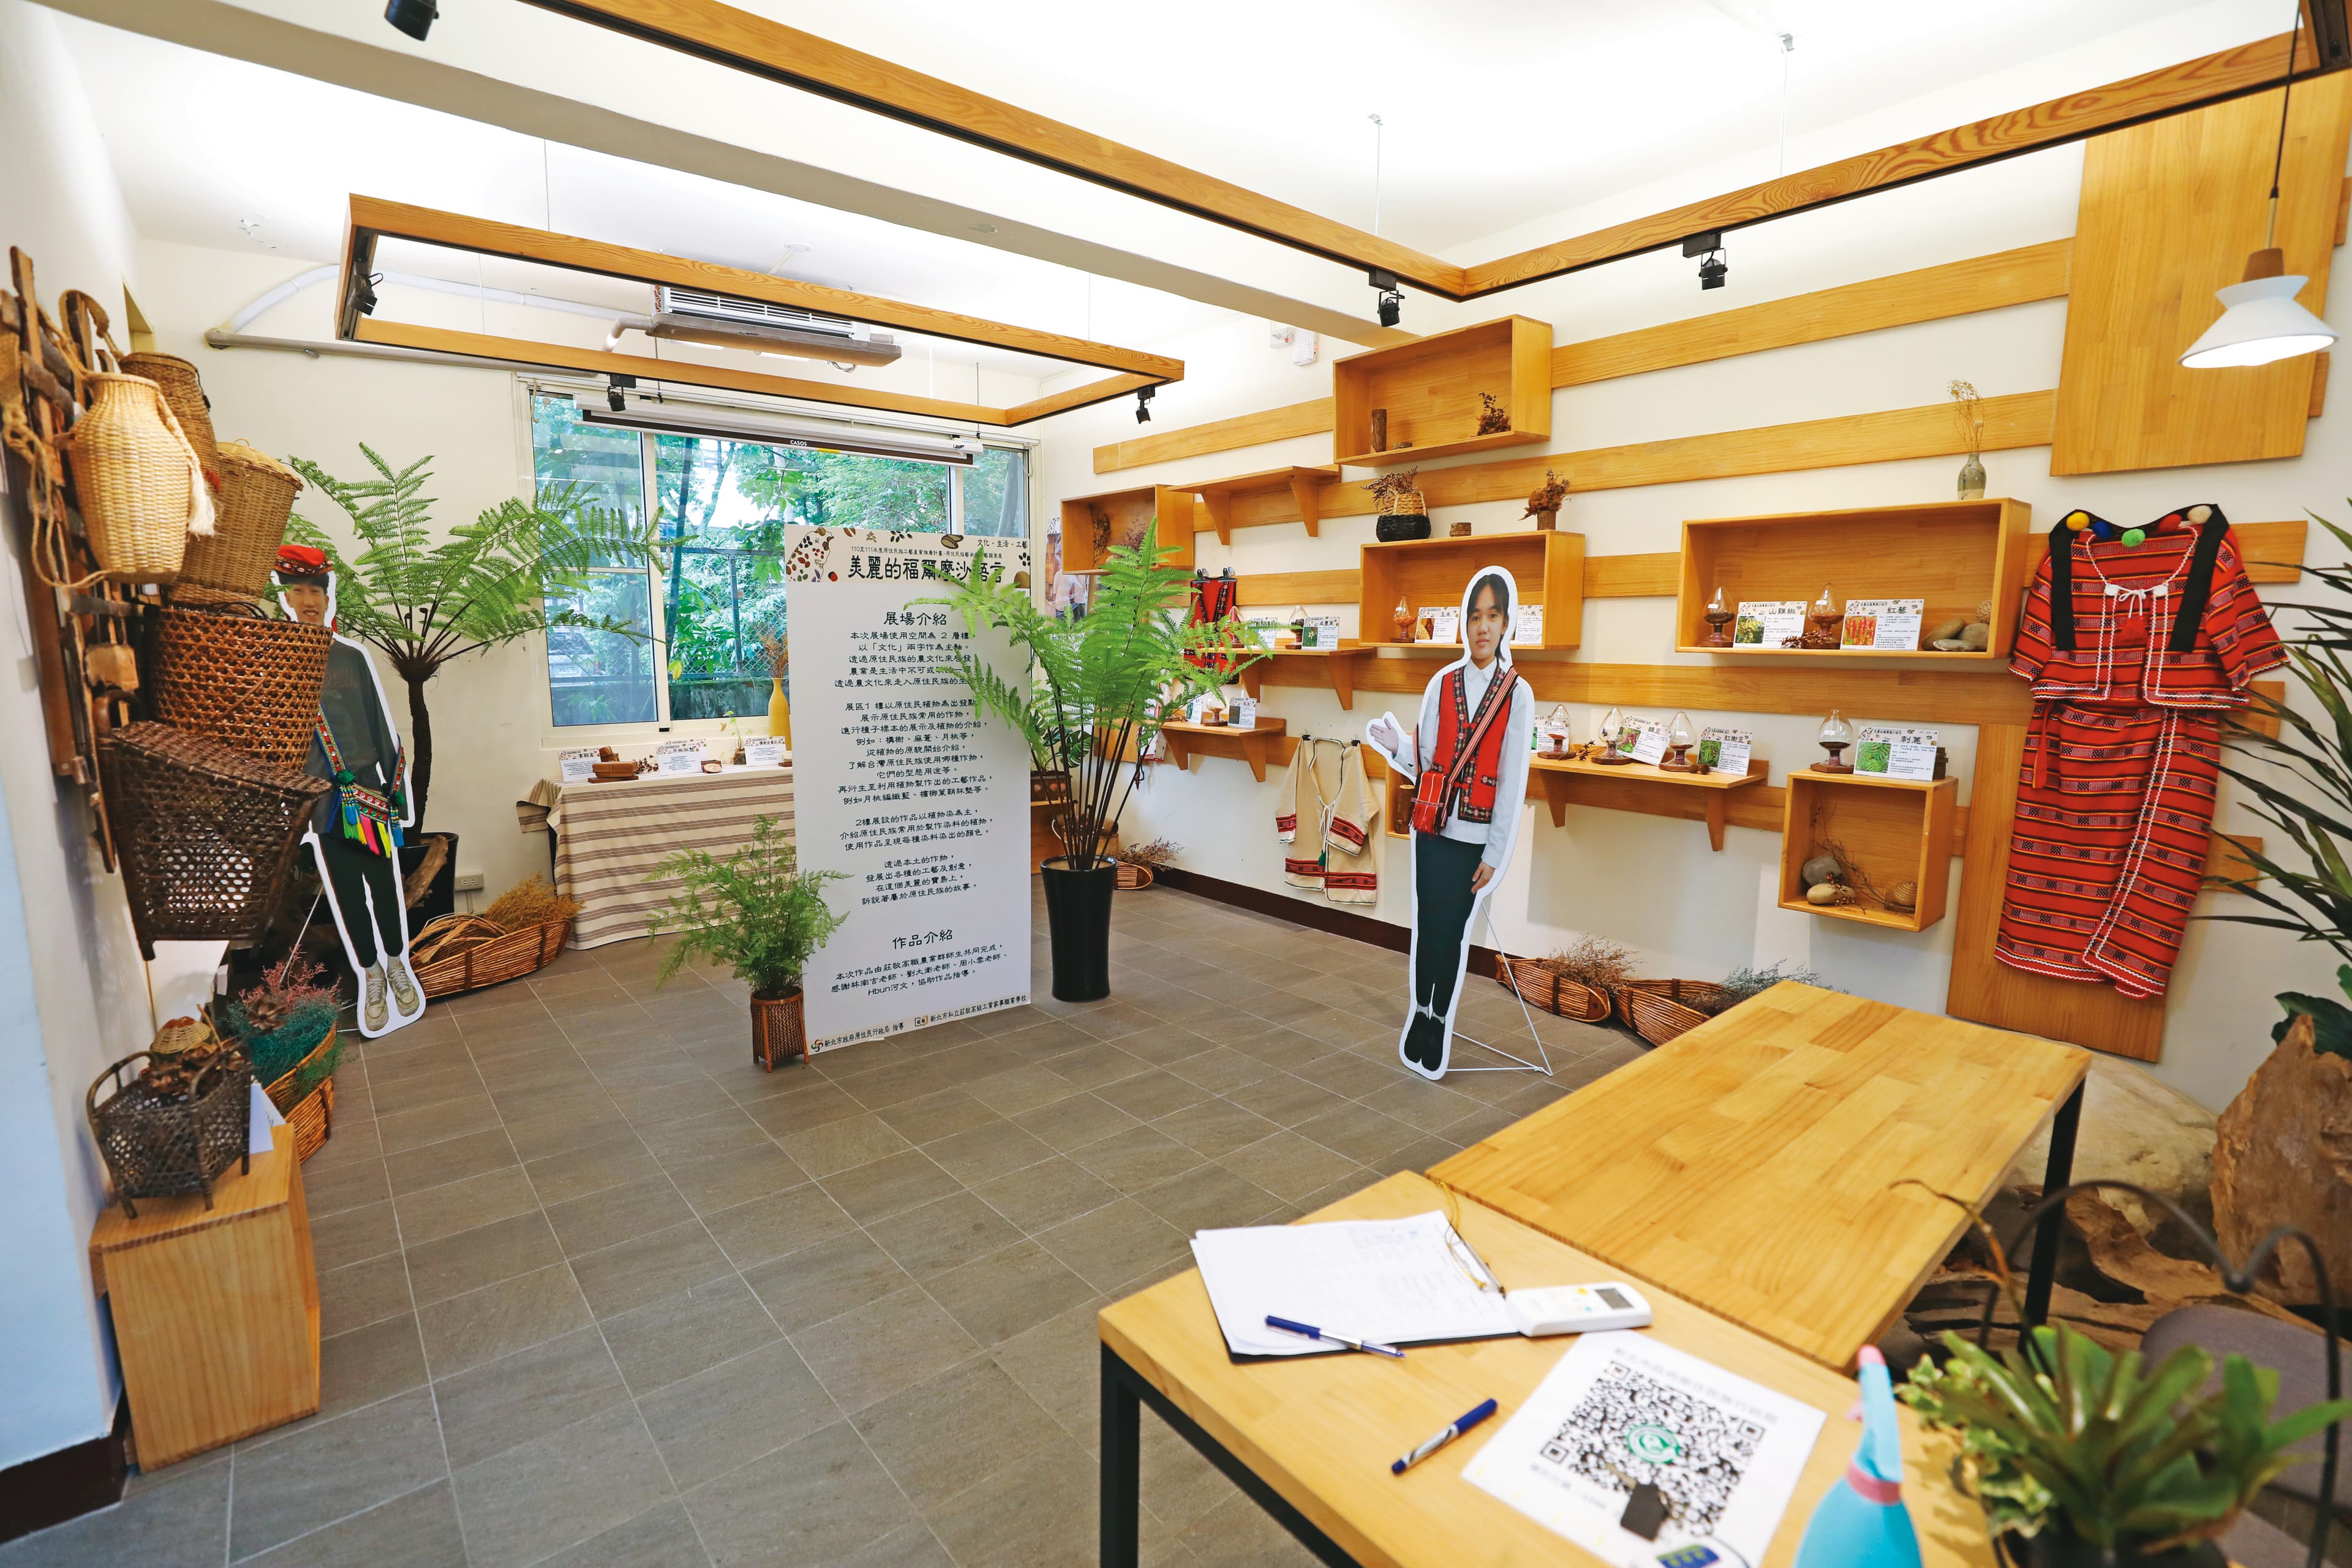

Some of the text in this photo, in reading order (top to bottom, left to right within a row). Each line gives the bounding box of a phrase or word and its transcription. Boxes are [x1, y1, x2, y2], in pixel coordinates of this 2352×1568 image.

[883, 611, 947, 627] 展場介紹
[850, 631, 936, 640] 本次展場使用空間為
[845, 703, 869, 711] 展區1
[860, 710, 970, 722] 展示原住民族常用的作物，
[892, 929, 953, 950] 作品介紹
